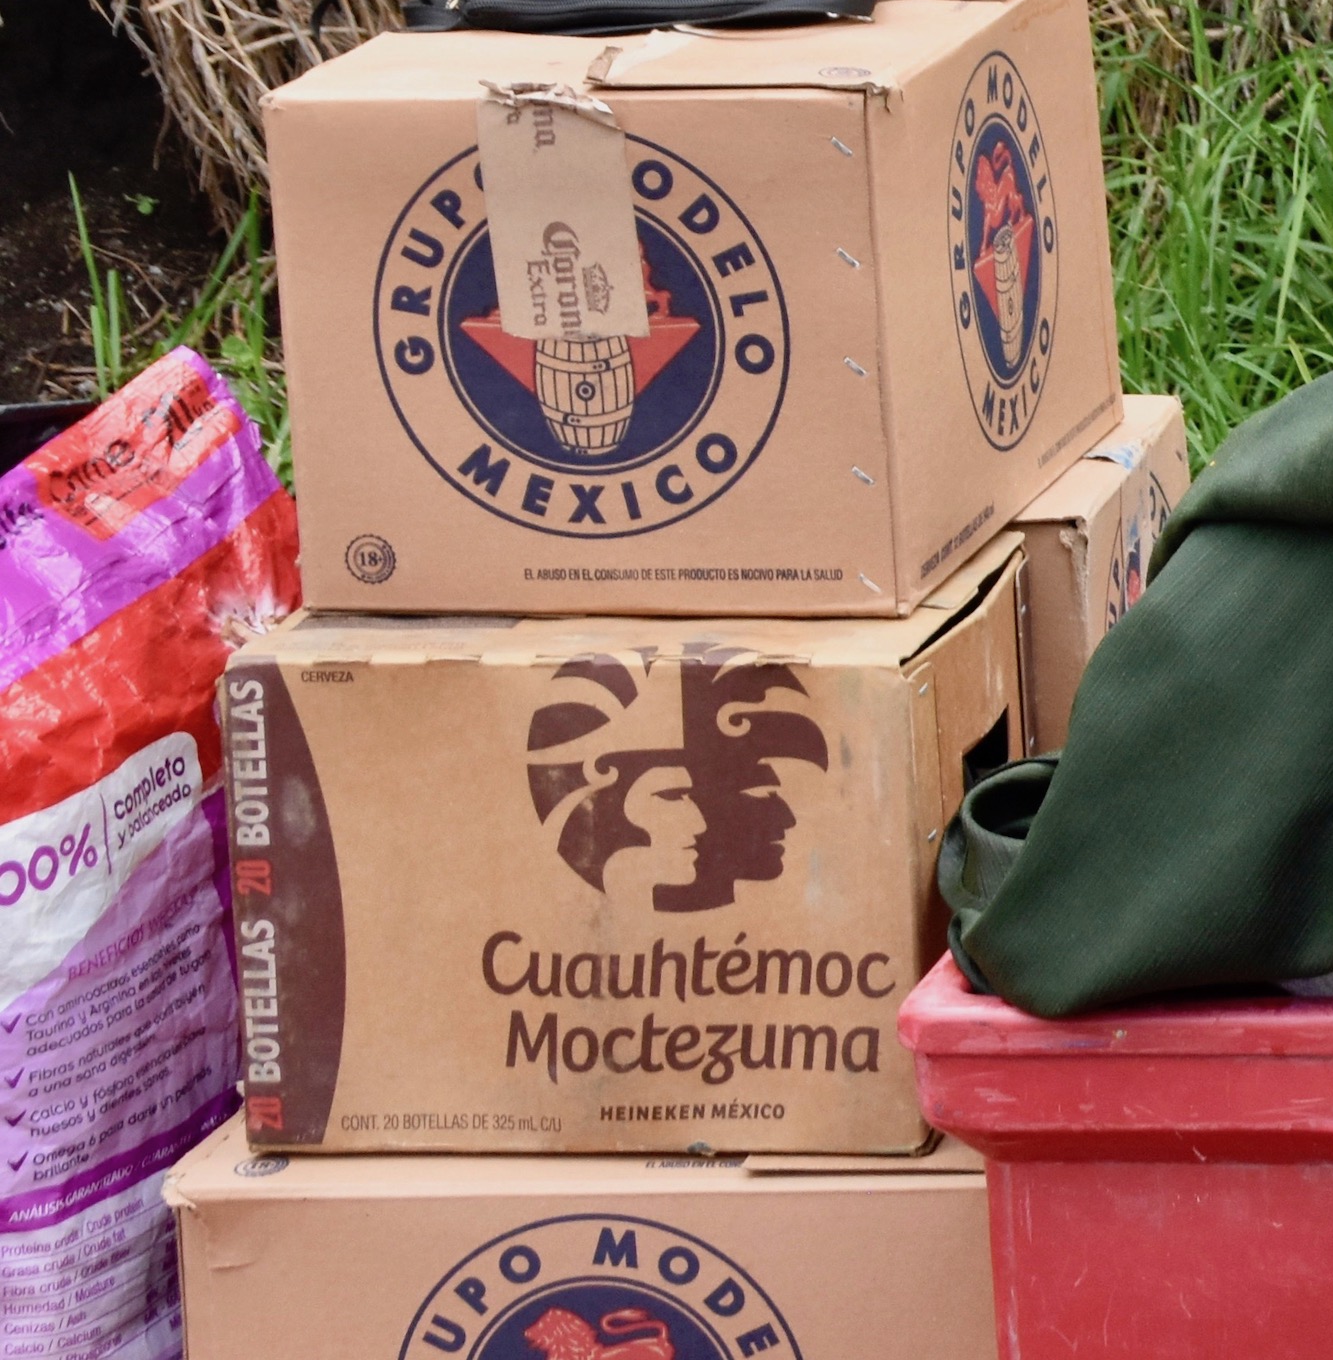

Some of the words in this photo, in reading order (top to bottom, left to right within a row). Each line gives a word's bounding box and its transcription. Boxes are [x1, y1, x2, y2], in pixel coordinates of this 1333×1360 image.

[951, 96, 976, 330] GRUPO
[986, 63, 1054, 254] MODELO
[391, 161, 486, 375] GRUP
[631, 159, 775, 375] ODELO
[541, 220, 583, 337] Coron
[526, 258, 551, 327] Extra
[981, 316, 1050, 438] MEXICO
[457, 432, 738, 524] MEXICO
[524, 568, 536, 581] EL
[537, 568, 566, 581] ABUSO
[569, 568, 580, 581] EN
[582, 568, 593, 581] EL
[595, 568, 639, 581] CONSUMO
[641, 568, 652, 581] DE
[655, 568, 676, 581] ESTE
[678, 568, 726, 581] PRODUCTO
[728, 568, 739, 581] ES
[741, 568, 774, 581] NOCIVO
[776, 568, 799, 581] PARA
[801, 568, 812, 581] LA
[814, 568, 843, 581] SALUD
[301, 670, 354, 683] CERVEZA
[230, 678, 271, 847] BOTELLAS
[113, 756, 186, 820] completo
[117, 831, 126, 850] y
[129, 783, 192, 839] balanceado
[0, 823, 98, 906] 00%
[236, 858, 273, 897] 20
[481, 930, 897, 1003] Cuauhtémoc
[26, 1017, 75, 1042] Taurina
[78, 1011, 87, 1026] y
[89, 987, 137, 1018] Arginina
[26, 1009, 54, 1027] Con
[241, 919, 281, 1083] BOTELLAS
[26, 1020, 104, 1057] adecuados
[504, 1010, 881, 1085] Moctezuma
[28, 1062, 75, 1084] Fibras
[28, 1086, 38, 1098] a
[43, 1076, 71, 1092] una
[30, 1099, 76, 1124] Calcio
[79, 1095, 89, 1109] y
[30, 1114, 84, 1138] huesos
[87, 1109, 96, 1123] y
[248, 1095, 284, 1132] 20
[341, 1115, 380, 1132] CONT.
[383, 1114, 399, 1131] 20
[402, 1114, 469, 1131] BOTELLAS
[471, 1114, 489, 1130] DE
[491, 1114, 515, 1130] 325
[517, 1114, 538, 1131] mL
[541, 1114, 562, 1133] C/U
[600, 1105, 706, 1121] HEINEKEN
[711, 1102, 785, 1120] MÉXICO
[33, 1143, 86, 1168] Omega
[9, 1196, 65, 1224] ANÁLISIS
[2, 1263, 41, 1279] Grasa
[3, 1298, 66, 1316] Humedad
[422, 1244, 542, 1353] UPO
[592, 1226, 781, 1359] MODE
[4, 1319, 55, 1335] Cenizas
[4, 1339, 44, 1357] Calcio
